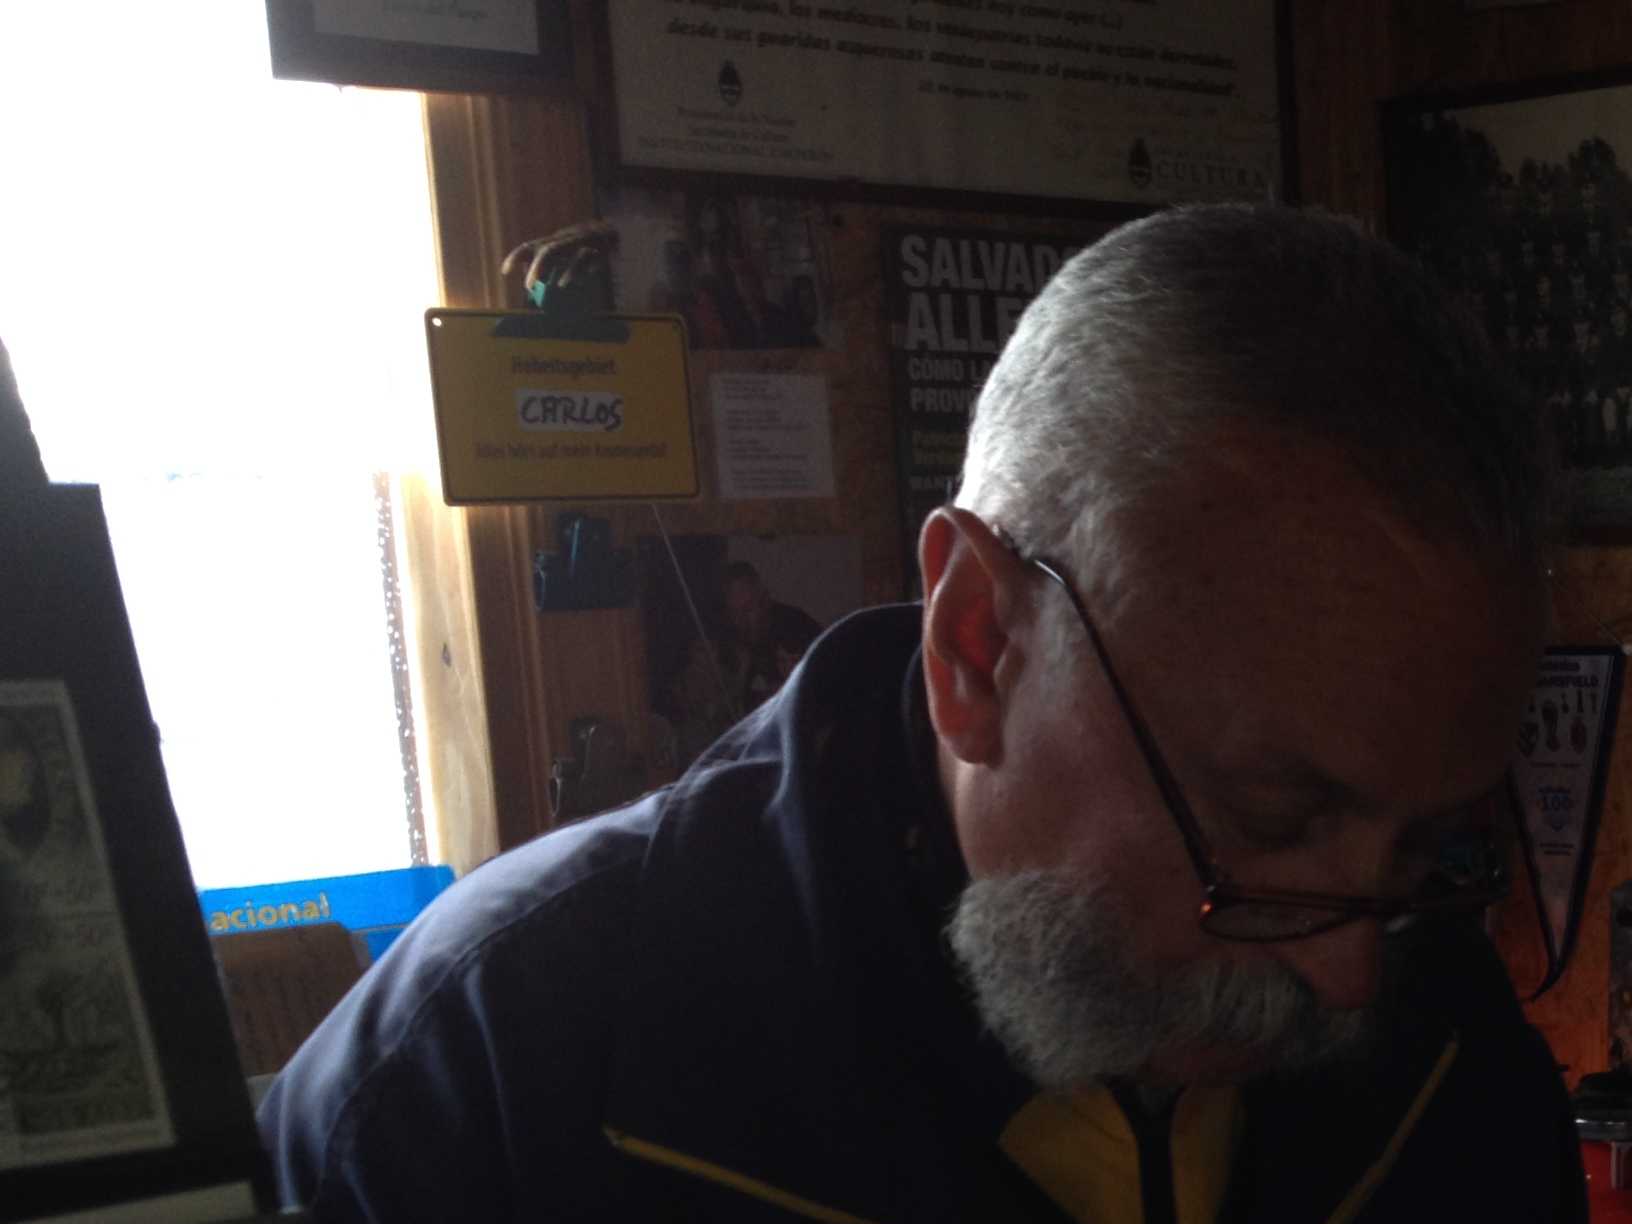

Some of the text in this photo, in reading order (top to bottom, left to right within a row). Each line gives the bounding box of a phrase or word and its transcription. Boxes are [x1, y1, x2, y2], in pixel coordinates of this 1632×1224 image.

[901, 233, 1080, 293] SALVAD
[521, 395, 624, 432] CARLOS
[210, 891, 331, 931] acional
